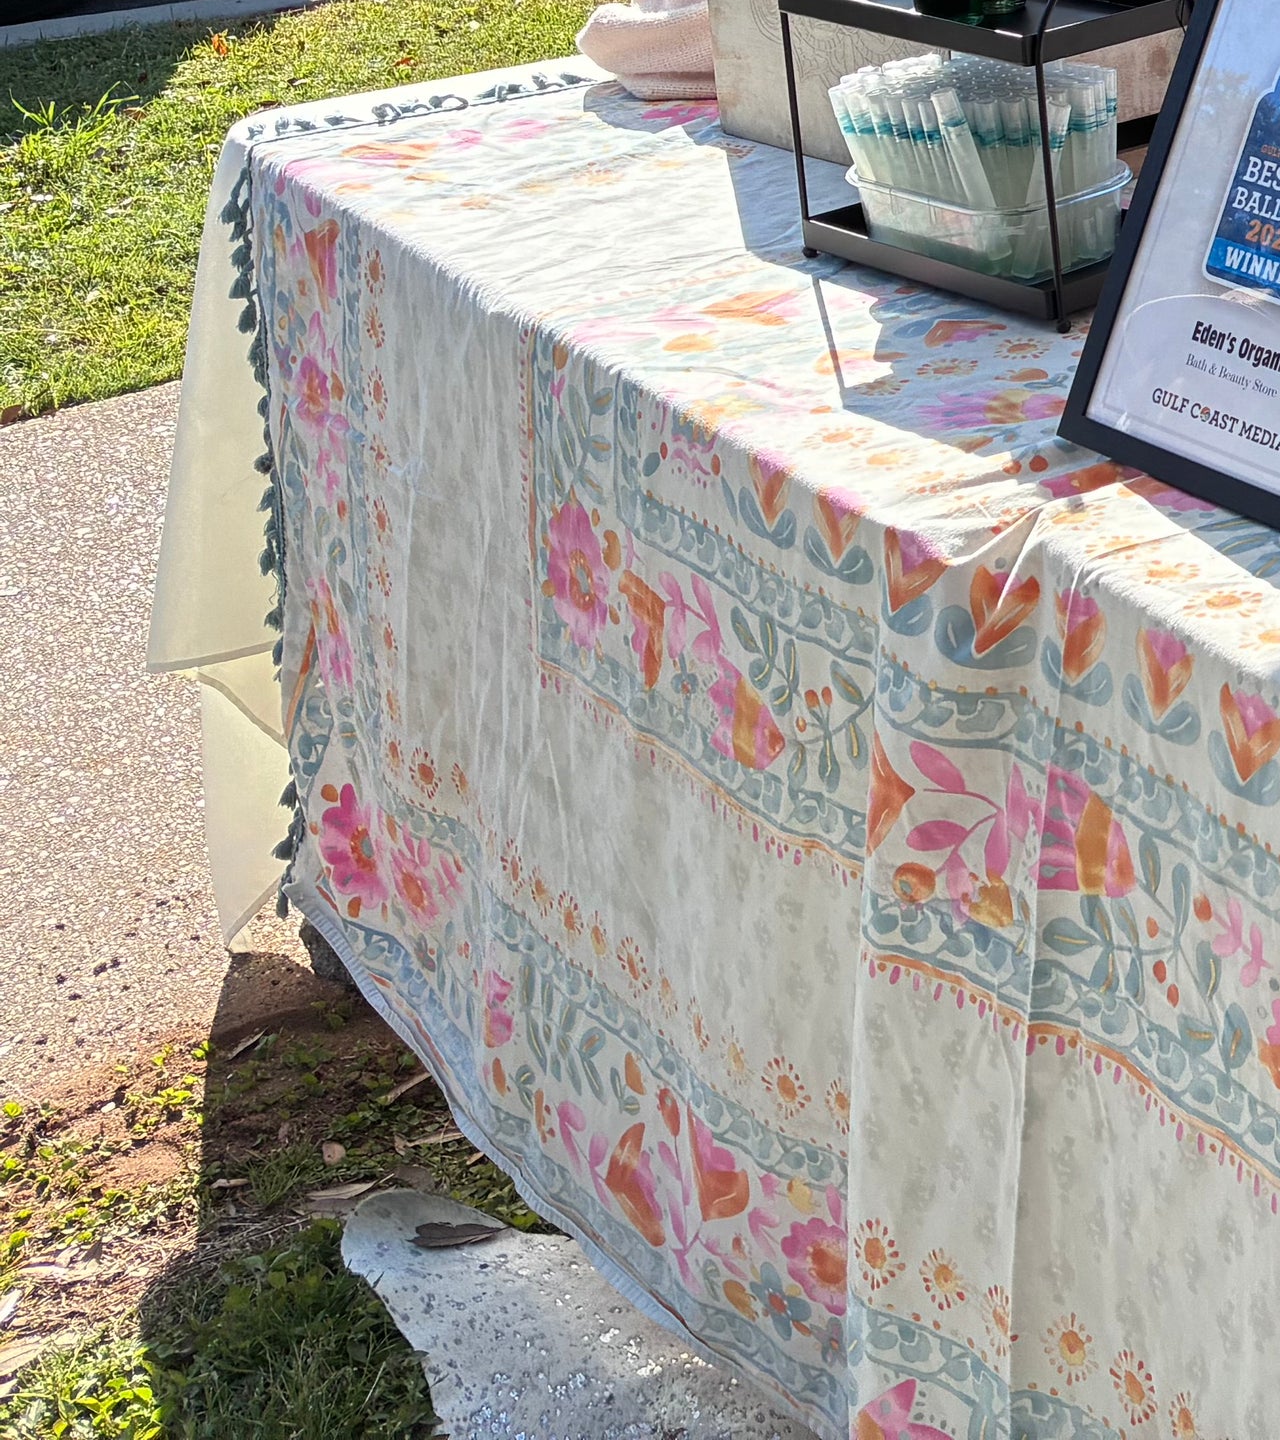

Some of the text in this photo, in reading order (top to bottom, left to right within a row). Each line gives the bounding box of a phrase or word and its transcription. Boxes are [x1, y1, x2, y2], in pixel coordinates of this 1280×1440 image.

[1191, 320, 1237, 354] Eden's
[1186, 353, 1278, 398] Bath & Beauty Store
[1152, 388, 1190, 414] GULF
[1190, 403, 1239, 433] COAST
